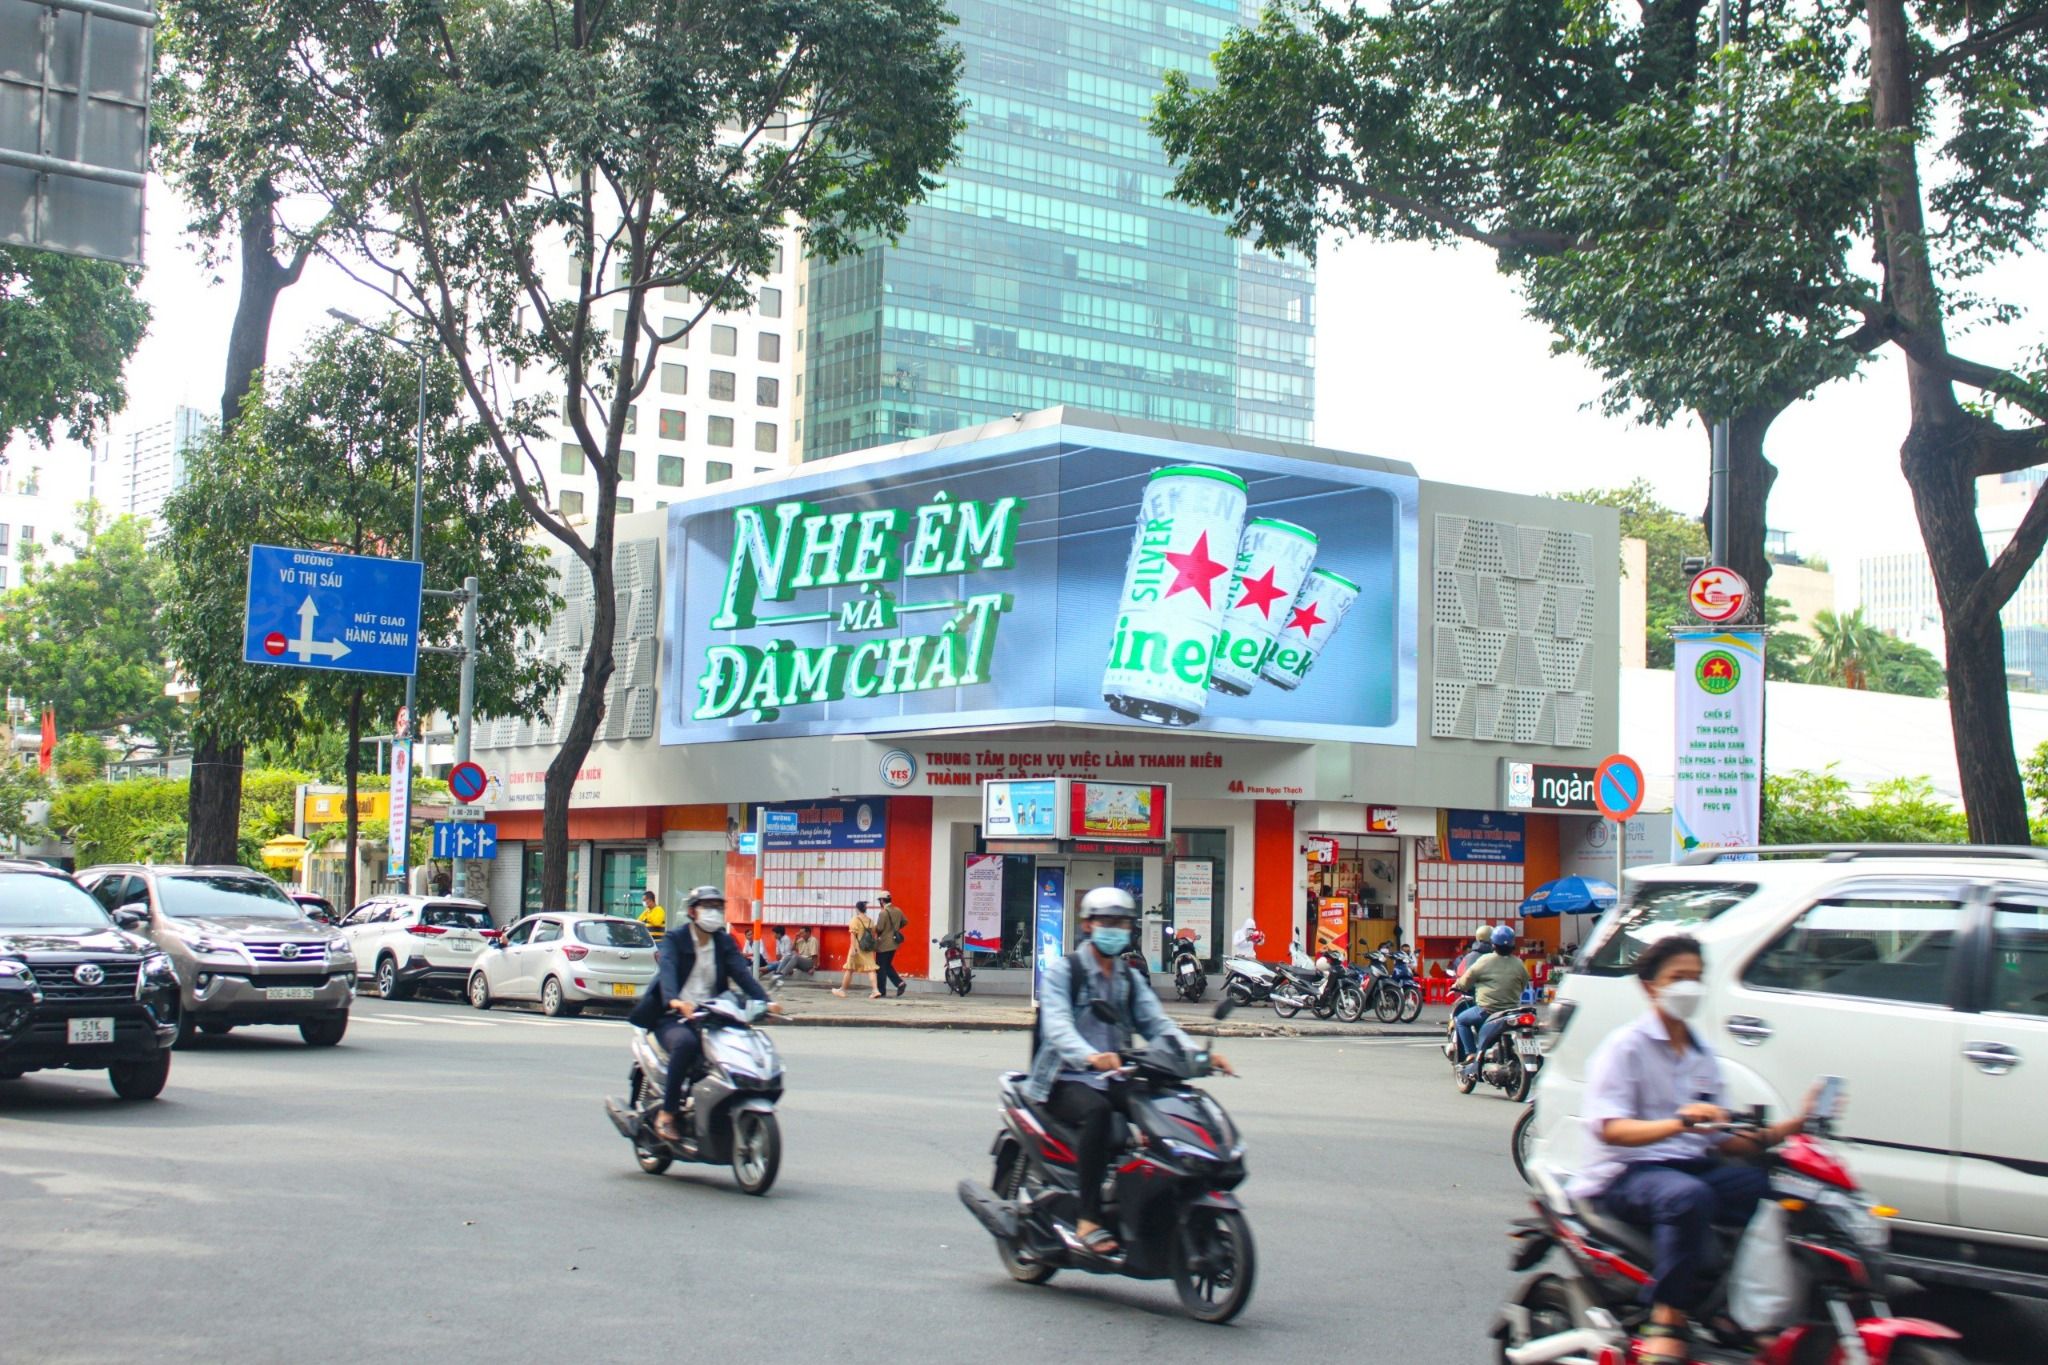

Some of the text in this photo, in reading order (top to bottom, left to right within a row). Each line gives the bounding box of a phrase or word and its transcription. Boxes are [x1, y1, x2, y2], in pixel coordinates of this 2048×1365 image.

[904, 490, 1026, 577] ÊM
[293, 553, 334, 567] ĐƯỜNG
[1132, 518, 1174, 602] SILVER
[280, 568, 343, 588] VÕ THỊ SÁU
[837, 589, 890, 632] MÀ
[354, 612, 405, 627] NÚT GIAO
[345, 626, 408, 646] HÀNG XANH
[693, 593, 1012, 724] ĐẬM CHẤT
[926, 749, 1223, 771] TRUNG TÂM DỊCH VỤ VIỆC LÀM THANH NIÊN
[890, 770, 909, 779] YES
[926, 768, 971, 785] THÀNH
[1227, 780, 1245, 794] 4A
[1107, 818, 1128, 830] 2022
[82, 1021, 101, 1030] 51K
[75, 1031, 109, 1041] 135.58
